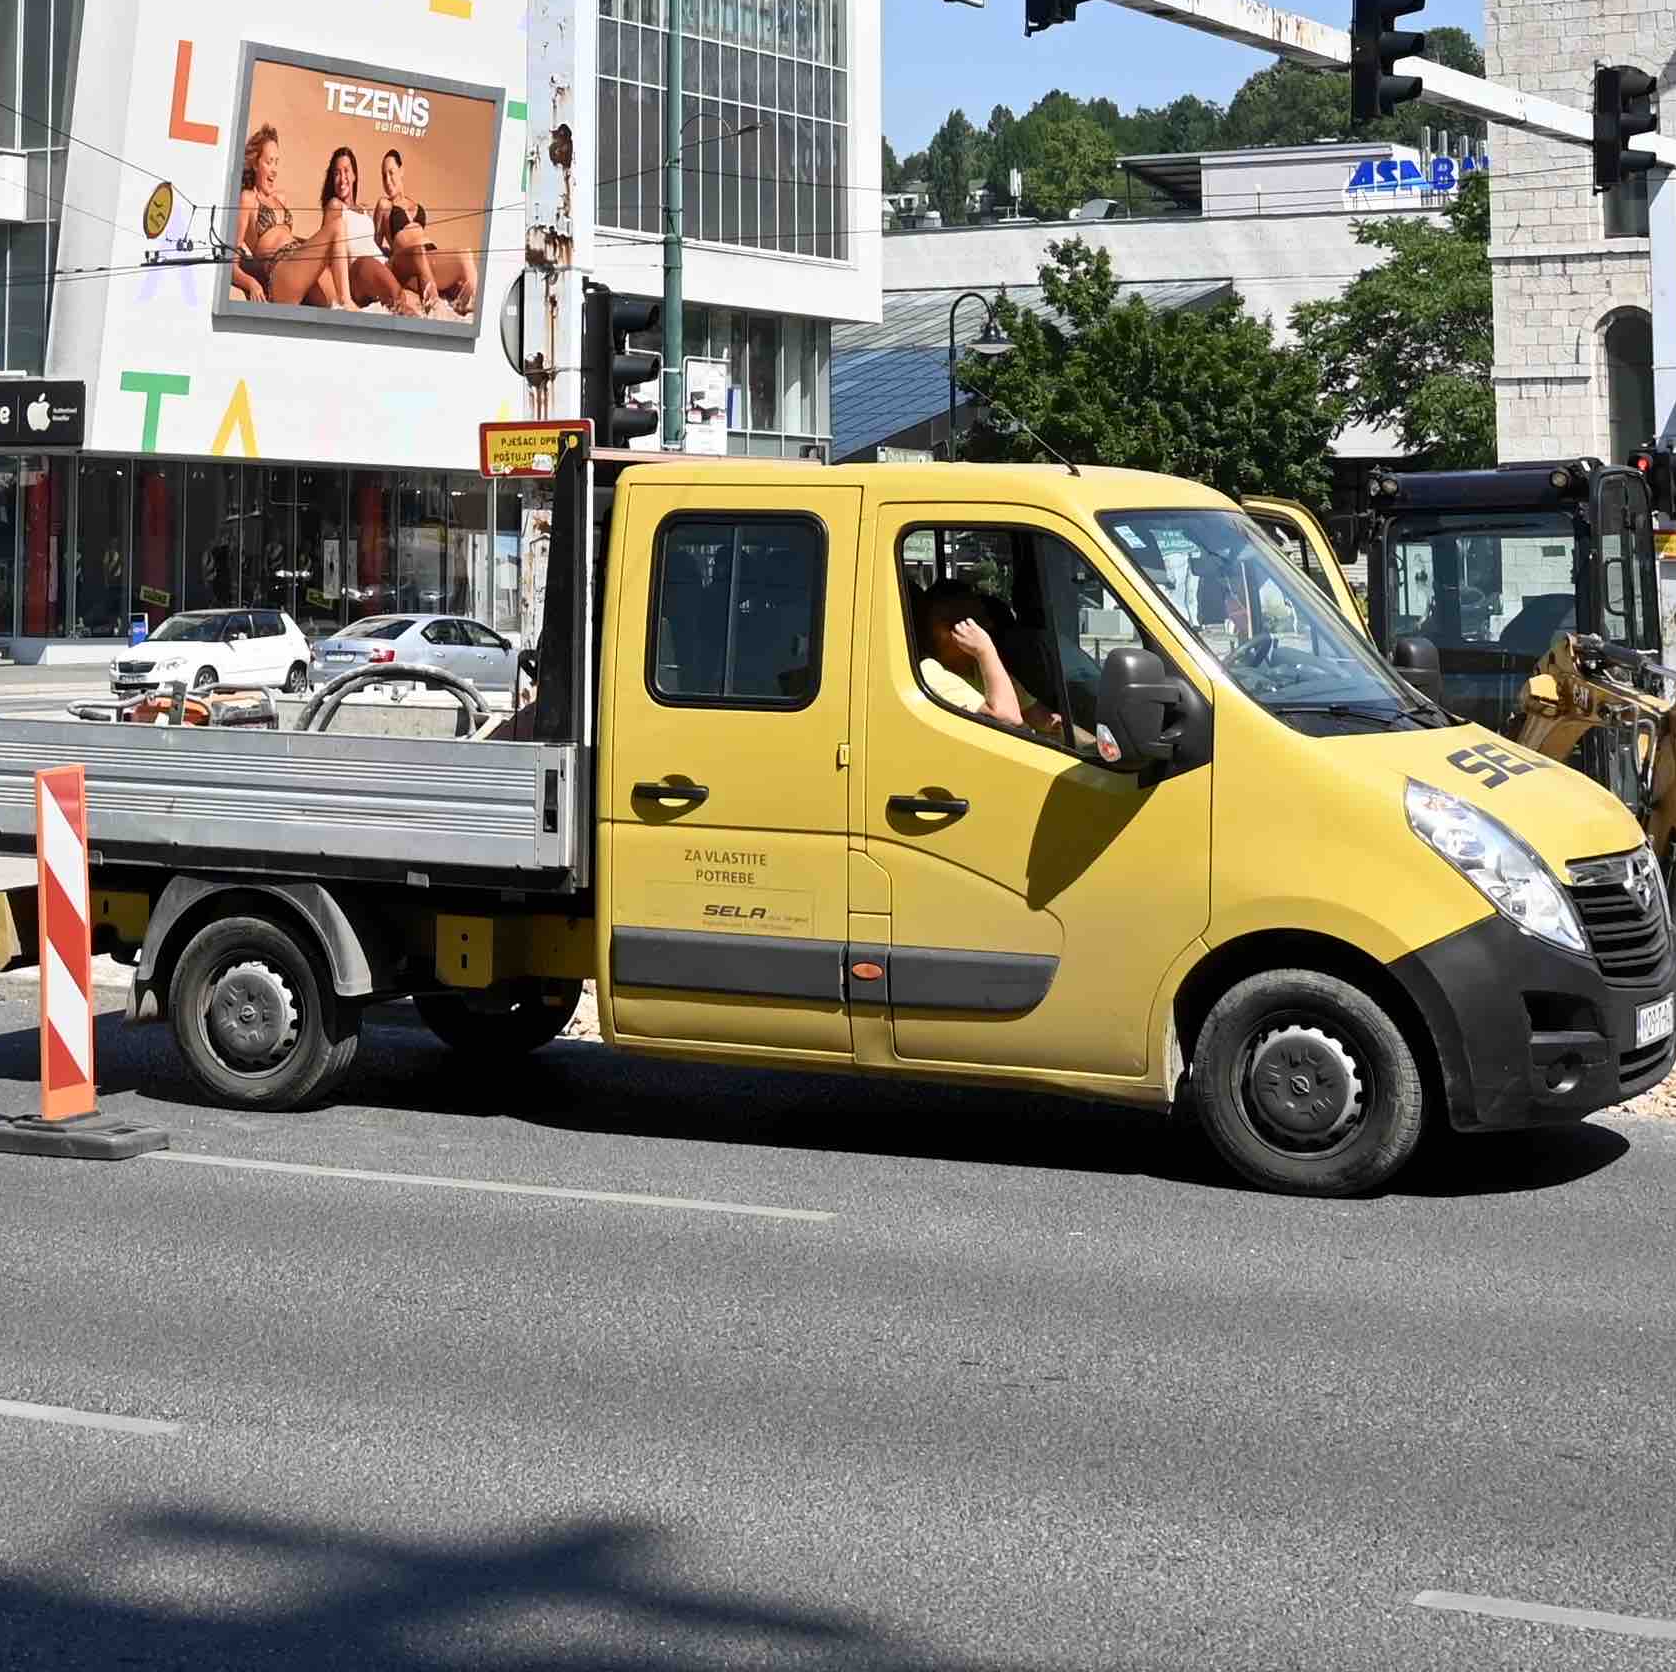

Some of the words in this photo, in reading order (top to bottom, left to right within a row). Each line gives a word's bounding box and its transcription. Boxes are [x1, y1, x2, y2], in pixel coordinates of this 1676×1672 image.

[1348, 160, 1424, 193] ASA
[501, 436, 536, 447] PJEŠACI
[540, 434, 556, 445] OPR
[685, 849, 701, 862] ZA
[705, 851, 766, 866] VLASTITE
[696, 870, 755, 884] POTREBE
[703, 905, 766, 919] SELA
